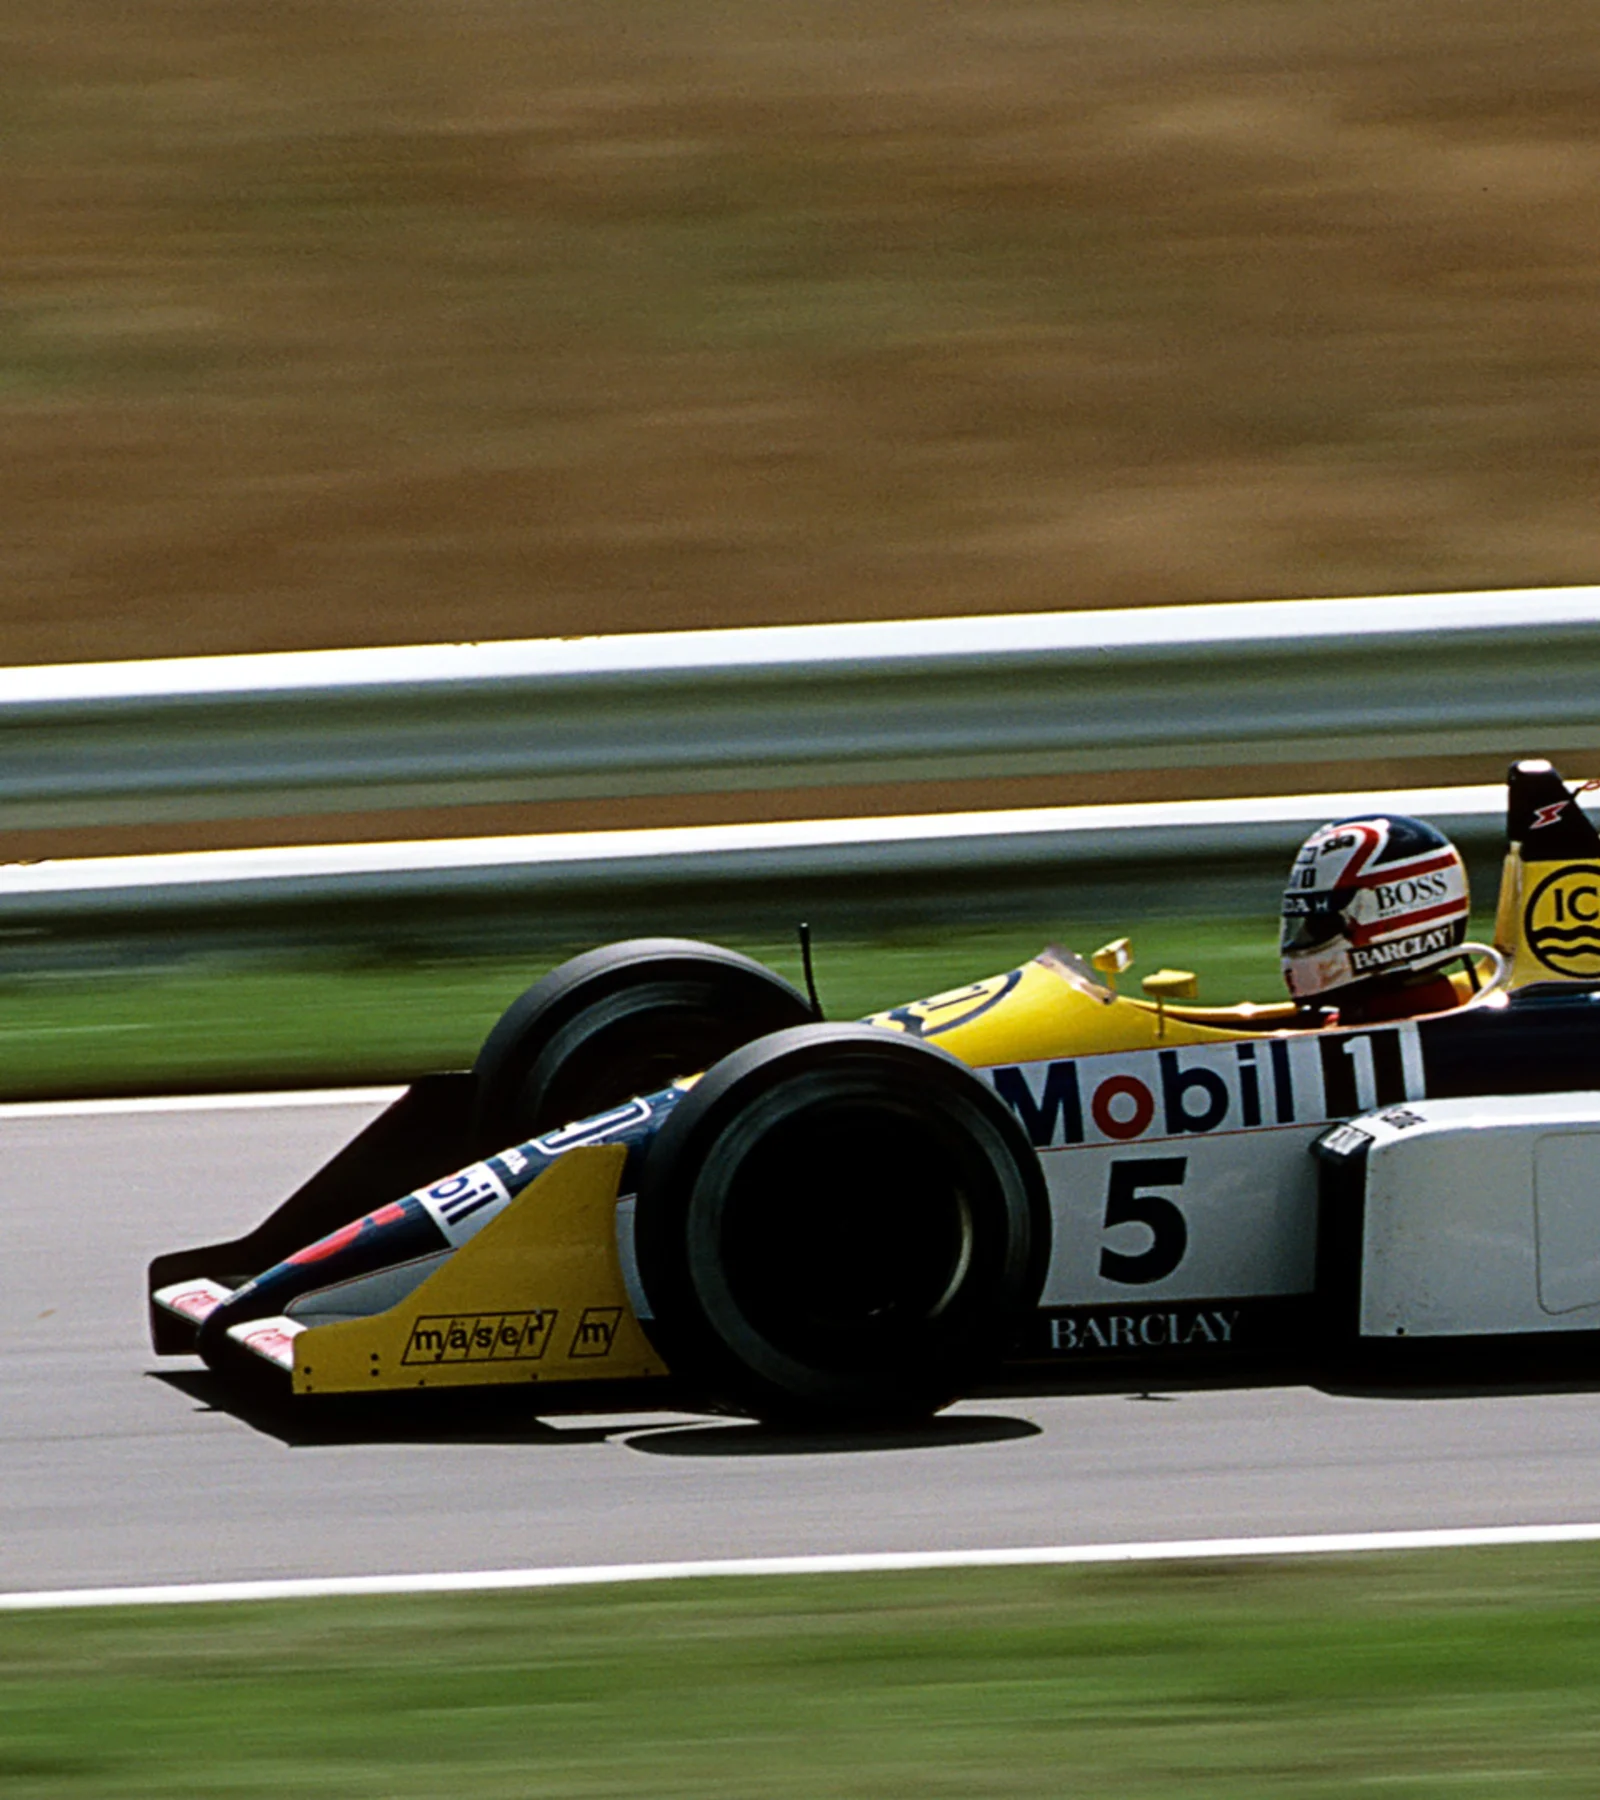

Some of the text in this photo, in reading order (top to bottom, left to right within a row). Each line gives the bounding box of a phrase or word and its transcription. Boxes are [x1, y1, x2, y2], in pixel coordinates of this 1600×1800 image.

[1375, 872, 1448, 911] BOSS
[1353, 927, 1450, 971] BARCLAY
[992, 1034, 1378, 1148] Mobil 1
[1098, 1156, 1189, 1285] 5
[1050, 1311, 1240, 1349] BARCLAY
